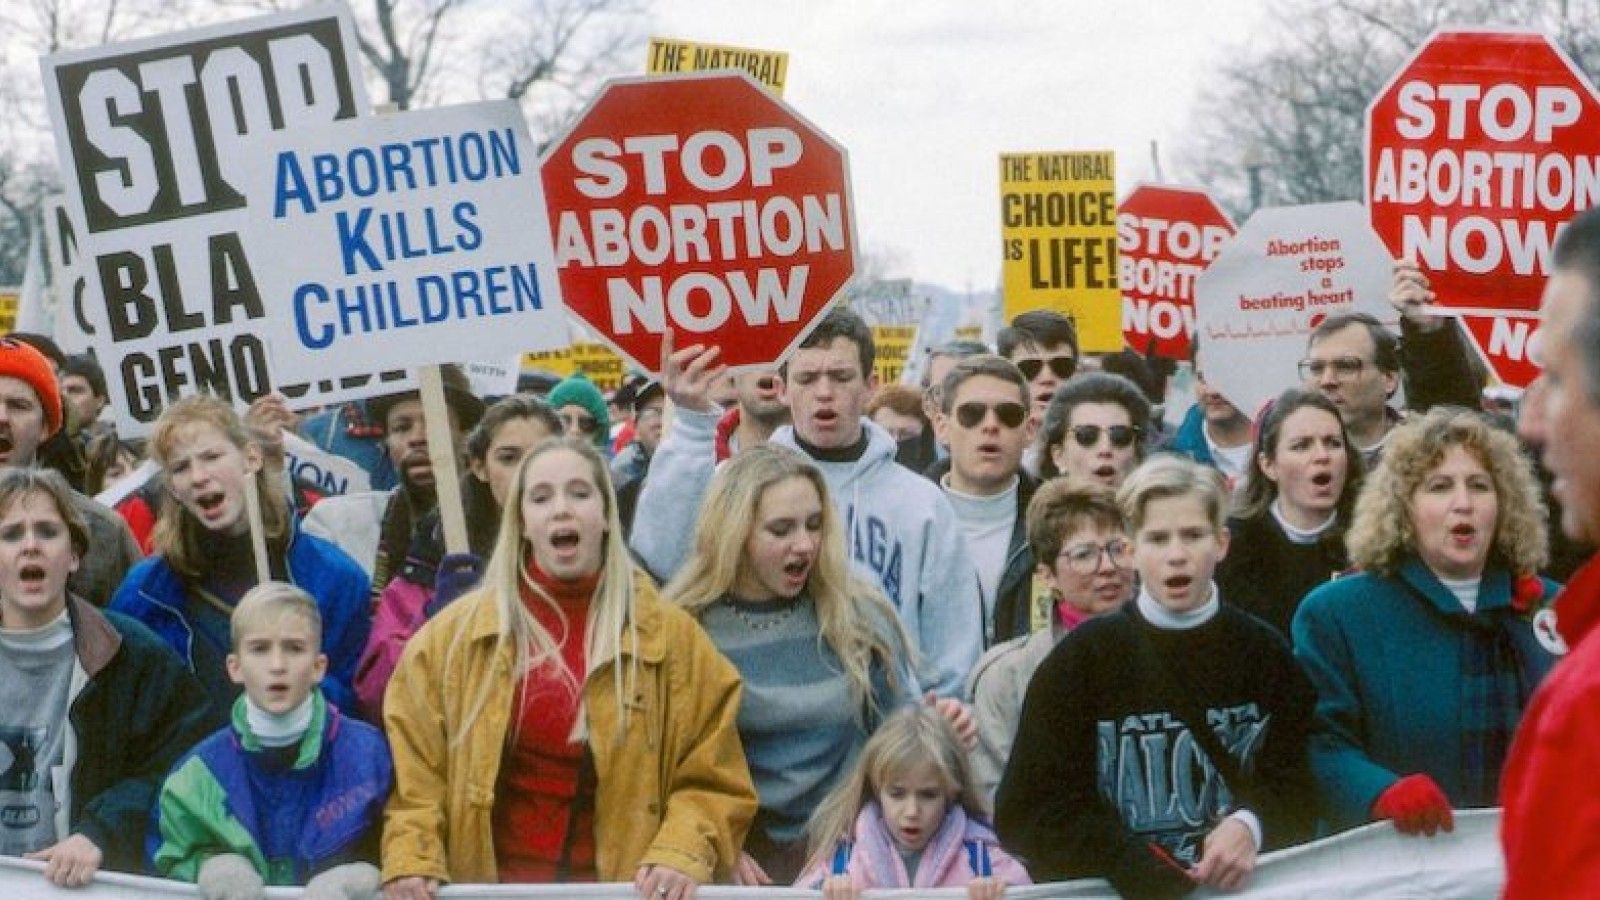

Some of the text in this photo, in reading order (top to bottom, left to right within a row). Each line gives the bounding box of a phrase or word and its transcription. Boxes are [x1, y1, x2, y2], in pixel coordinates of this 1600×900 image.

[651, 41, 784, 87] THE NATURAL
[79, 34, 341, 217] STOP
[1396, 80, 1582, 142] STOP
[273, 128, 522, 218] ABORTION
[571, 127, 804, 200] STOP
[1002, 155, 1113, 182] THE NATURAL
[1374, 147, 1600, 212] ABORTION
[336, 201, 483, 276] KILLS
[556, 193, 845, 269] ABORTION
[1003, 191, 1114, 228] CHOICE
[1117, 213, 1229, 261] STOP
[1004, 235, 1117, 289] IS LIFE!
[1266, 237, 1340, 258] Abortion
[1300, 256, 1344, 273] stops
[1402, 214, 1562, 276] NOW
[95, 231, 266, 343] BLA
[293, 262, 543, 351] CHILDREN
[606, 265, 810, 336] NOW
[1120, 256, 1201, 299] BORT
[1240, 289, 1354, 312] beating heart
[1322, 278, 1332, 289] a
[285, 452, 348, 495] ION
